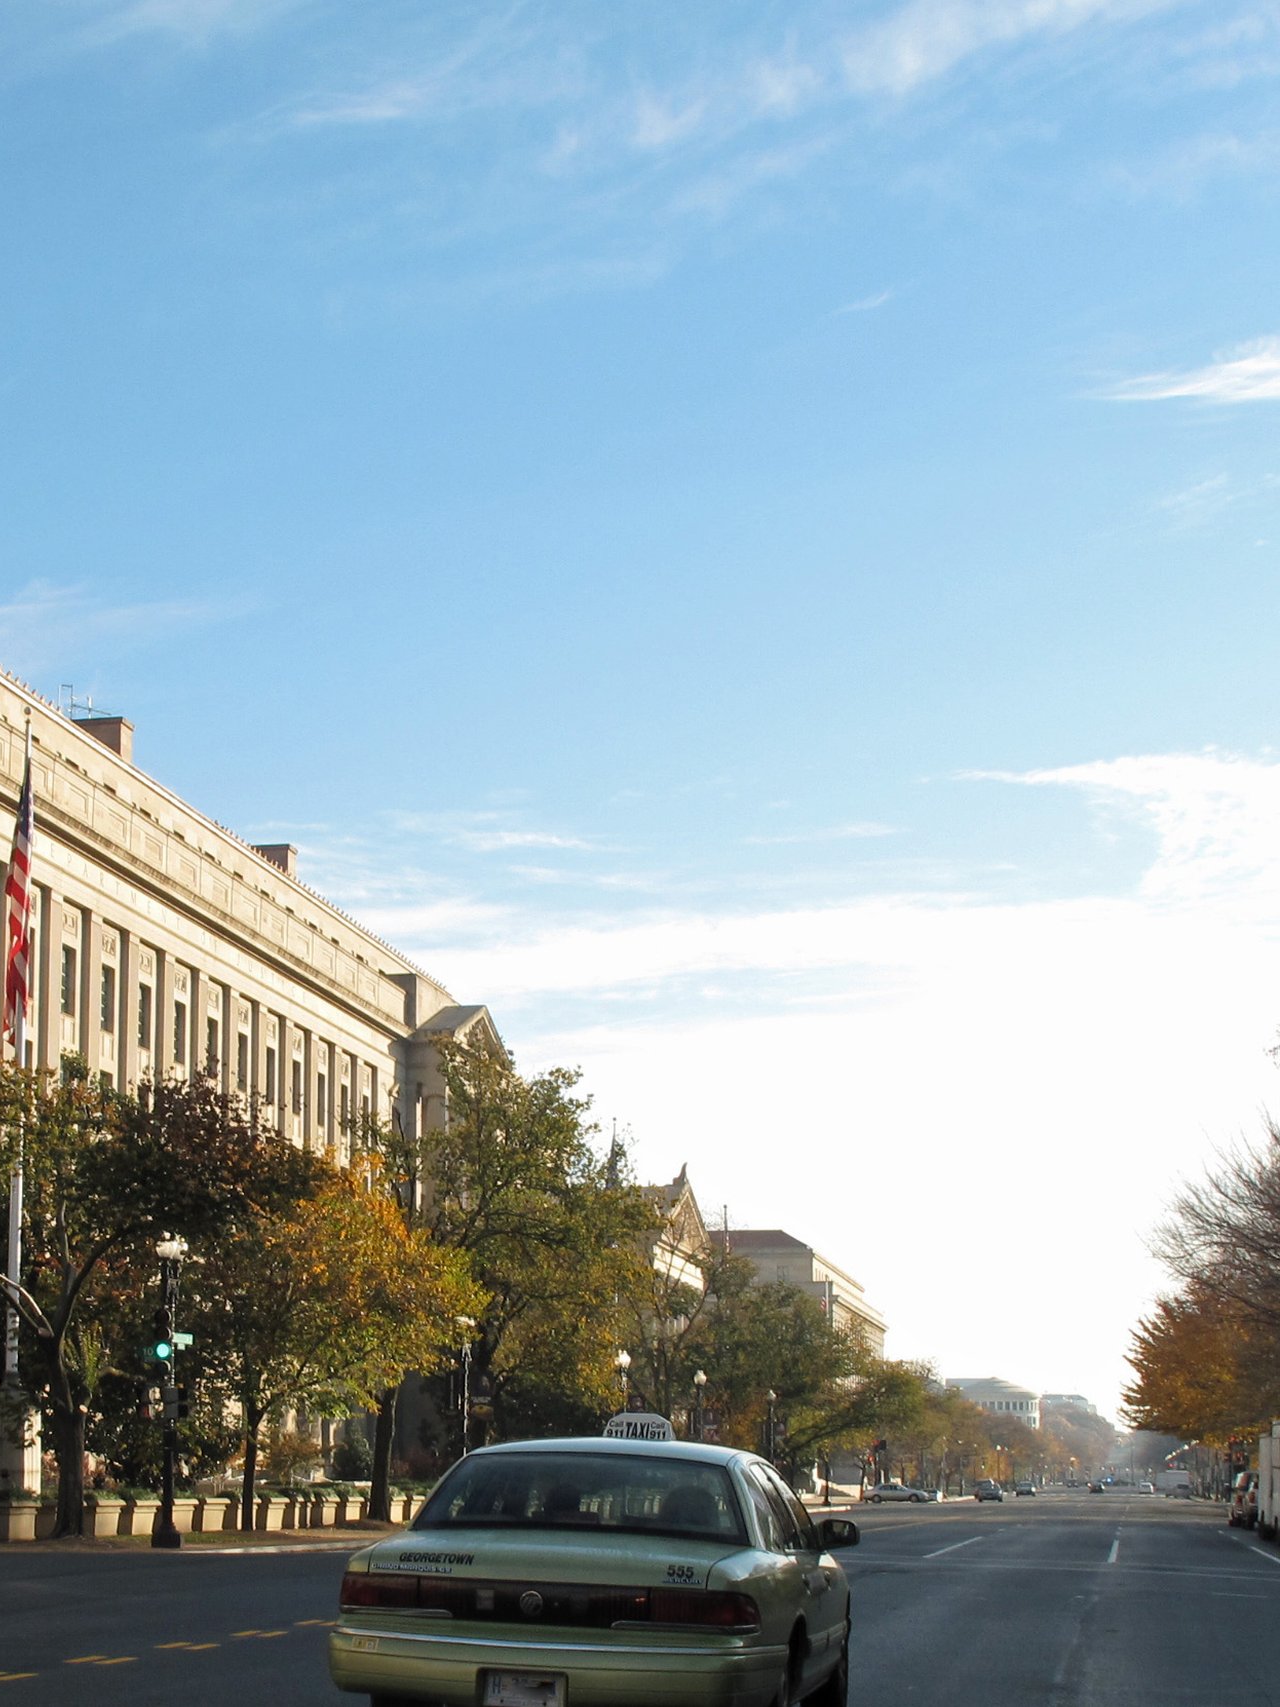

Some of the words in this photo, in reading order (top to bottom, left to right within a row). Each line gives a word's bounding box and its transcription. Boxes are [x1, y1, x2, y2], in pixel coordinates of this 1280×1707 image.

[626, 1421, 650, 1439] TAXI
[650, 1421, 665, 1429] Call
[607, 1429, 624, 1438] 911
[650, 1430, 666, 1439] 911
[399, 1552, 474, 1565] GEORGETOWN
[667, 1565, 694, 1578] 555
